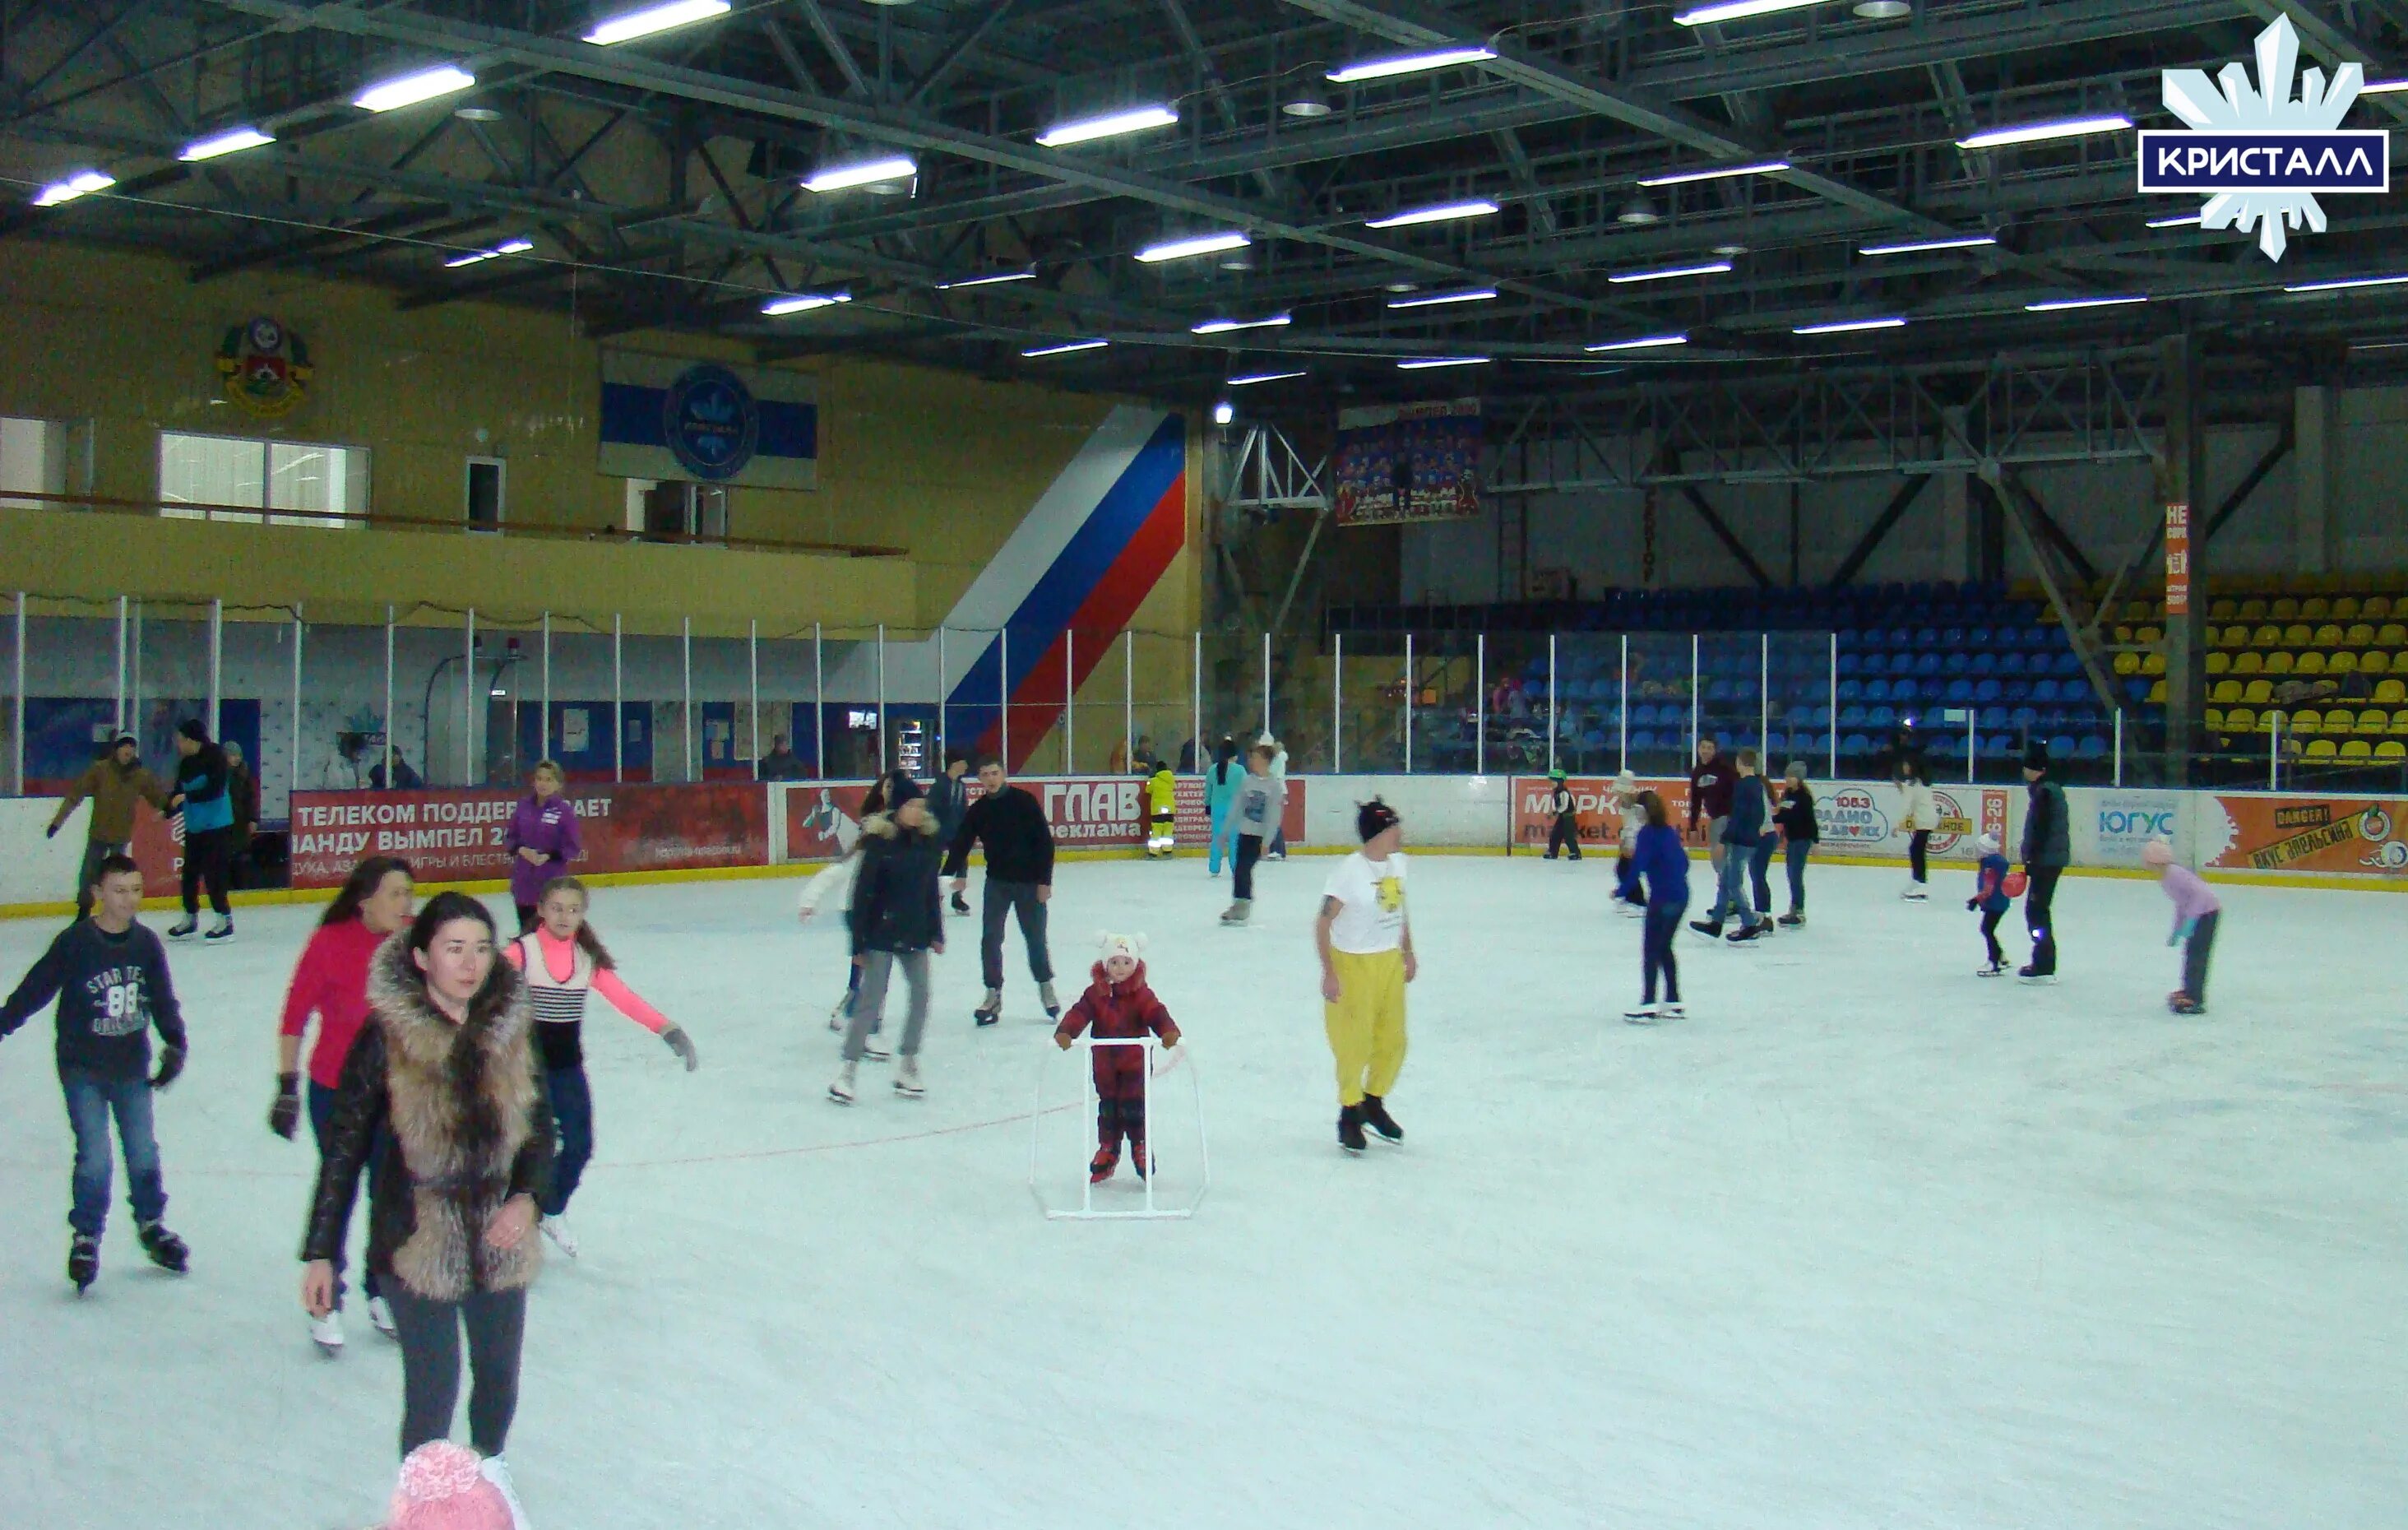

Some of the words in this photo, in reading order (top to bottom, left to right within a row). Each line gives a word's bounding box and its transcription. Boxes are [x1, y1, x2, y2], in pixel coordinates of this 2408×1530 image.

[298, 802, 415, 827] ТЕЛЕКОМ
[1043, 782, 1141, 823] ГЛАВ
[2099, 810, 2174, 835] ЮГУС
[377, 828, 484, 851] ВЫМПЕЛ
[86, 967, 123, 994] STAR
[108, 982, 139, 1017] 88
